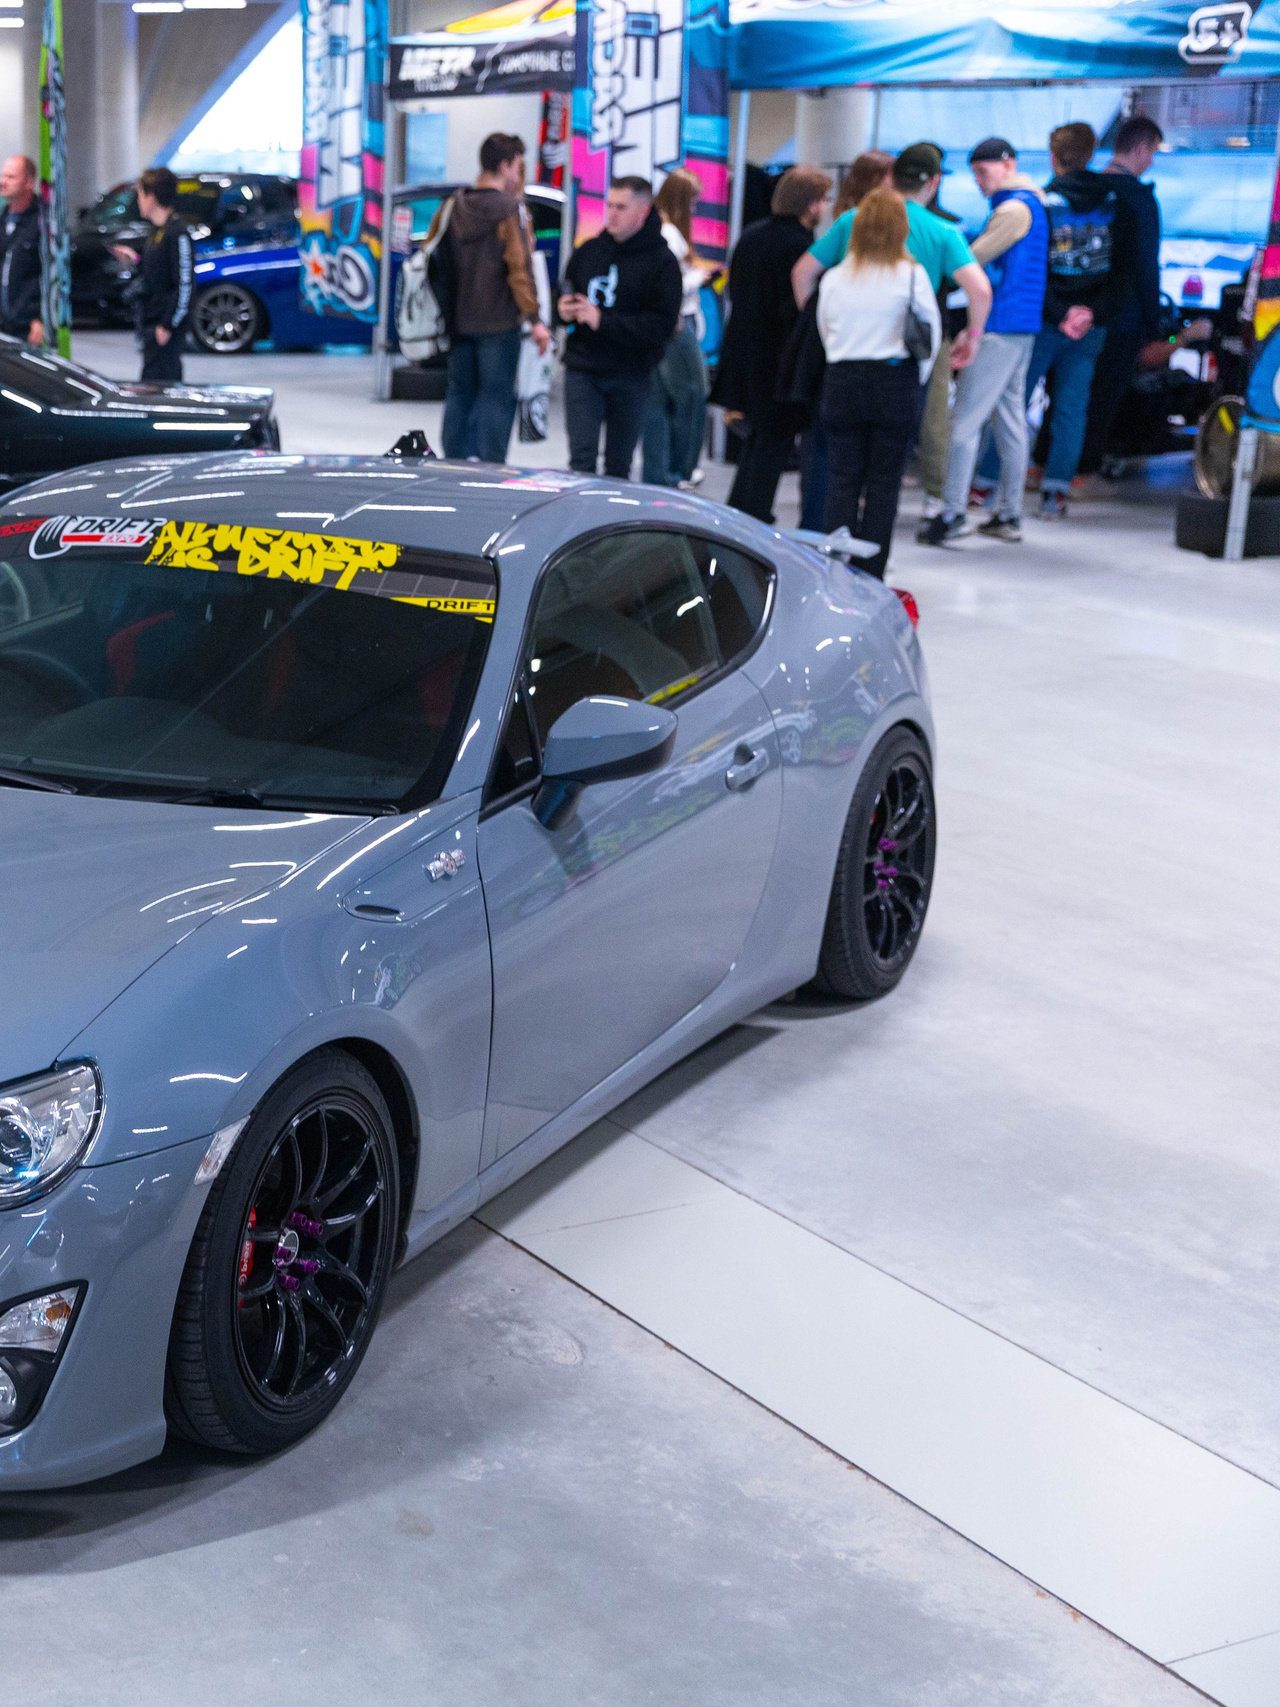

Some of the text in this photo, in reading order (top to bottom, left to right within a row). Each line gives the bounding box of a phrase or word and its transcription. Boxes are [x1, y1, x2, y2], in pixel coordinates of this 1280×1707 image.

[71, 518, 163, 534] DRIFT
[99, 533, 138, 543] EXPO
[237, 549, 360, 591] DRIFT
[426, 599, 496, 611] DRIFT
